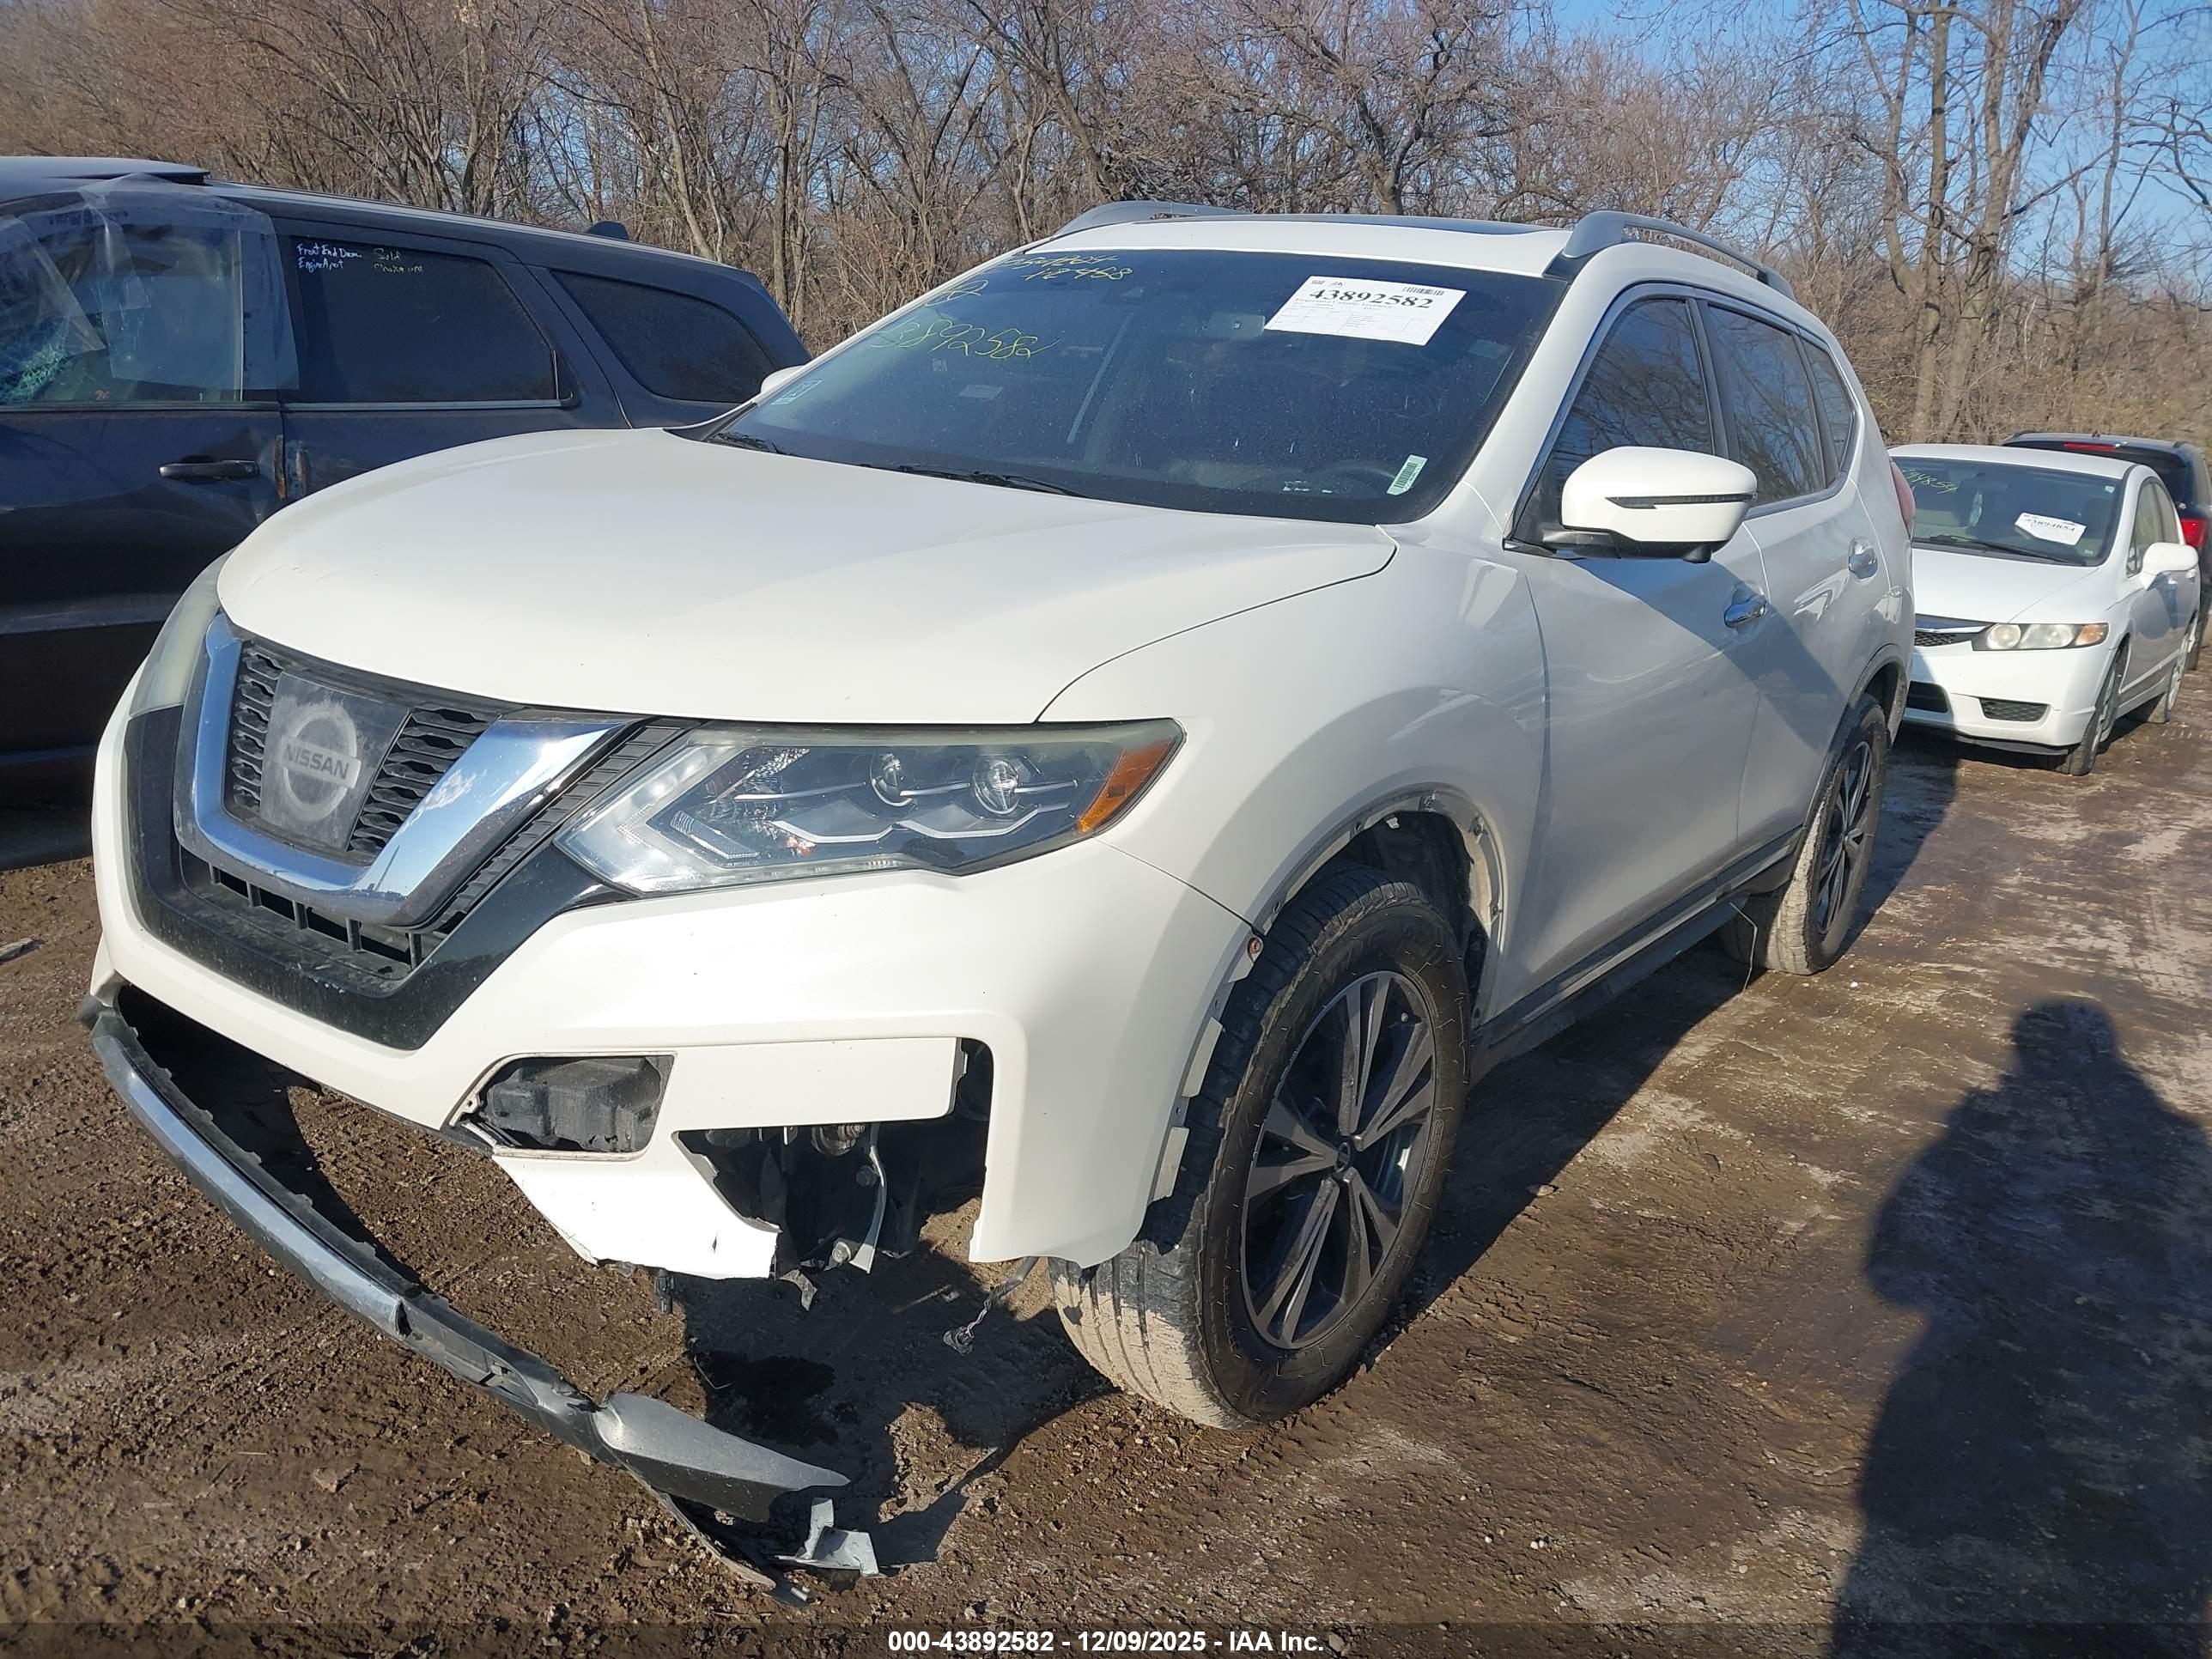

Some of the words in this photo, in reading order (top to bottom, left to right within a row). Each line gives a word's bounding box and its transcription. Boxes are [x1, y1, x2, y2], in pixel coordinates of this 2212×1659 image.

[321, 245, 337, 257] End
[1310, 289, 1433, 308] 43892582
[283, 743, 350, 780] NISSAN
